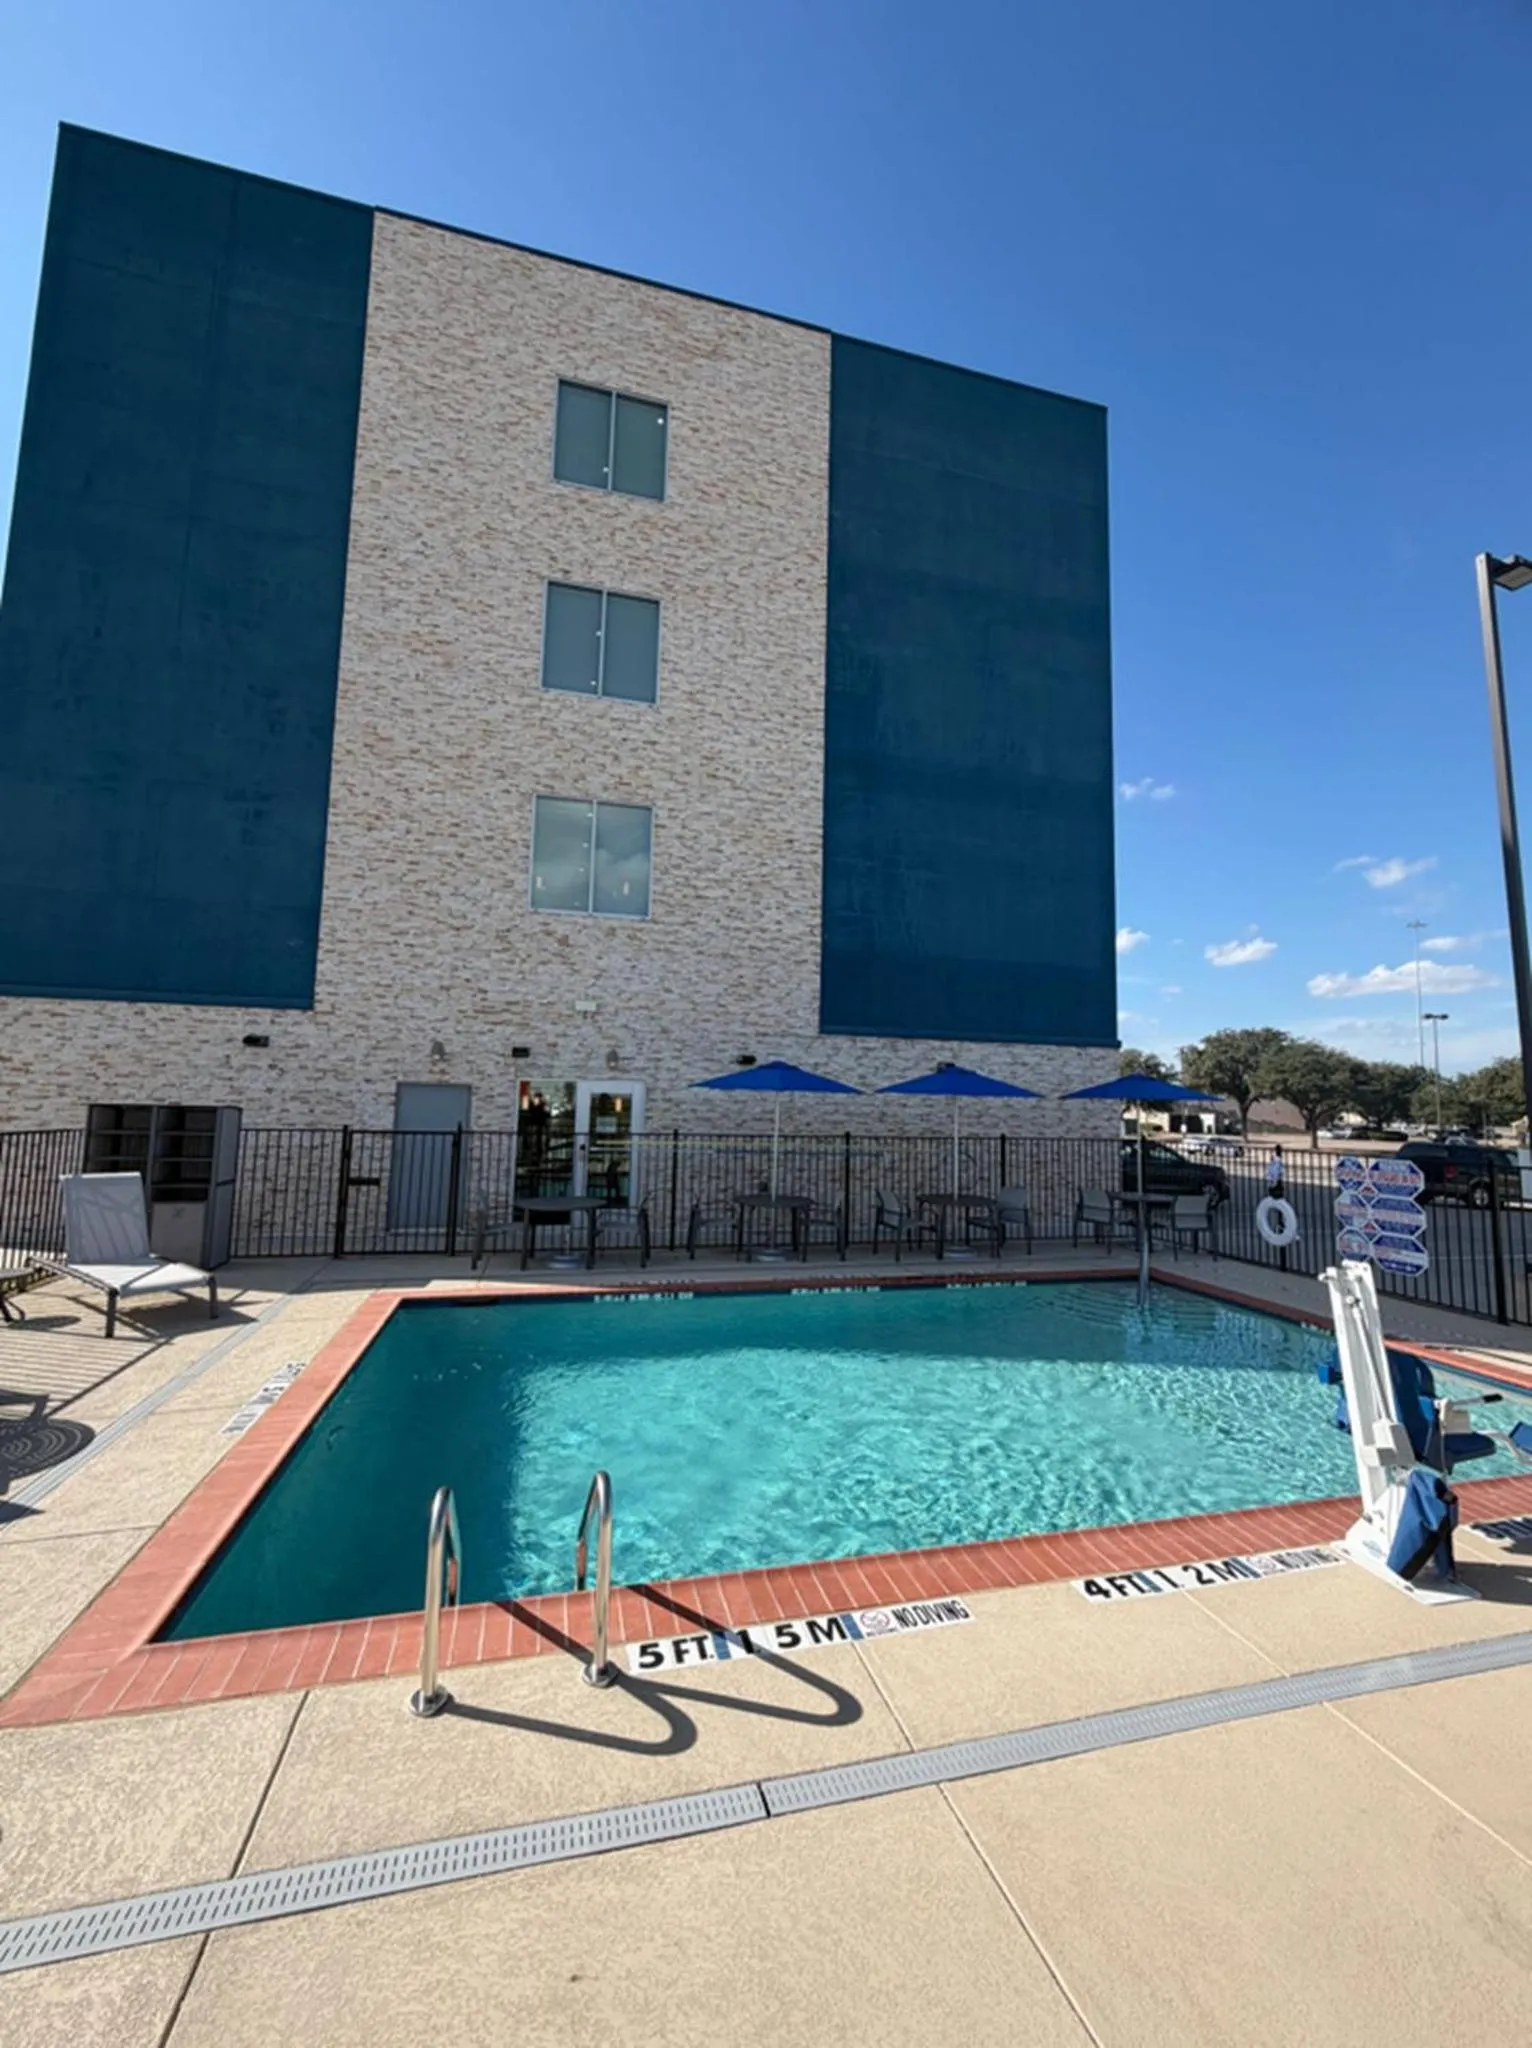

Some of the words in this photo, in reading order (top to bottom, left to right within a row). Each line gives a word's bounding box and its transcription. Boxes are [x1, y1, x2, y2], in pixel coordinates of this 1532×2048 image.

[1083, 1579, 1111, 1598] 4
[1182, 1565, 1216, 1585] 2
[1205, 1560, 1249, 1581] M
[891, 1607, 918, 1629] NO
[911, 1600, 970, 1626] DIVING
[638, 1643, 664, 1669] 5
[774, 1623, 802, 1648] 5
[805, 1614, 848, 1645] M
